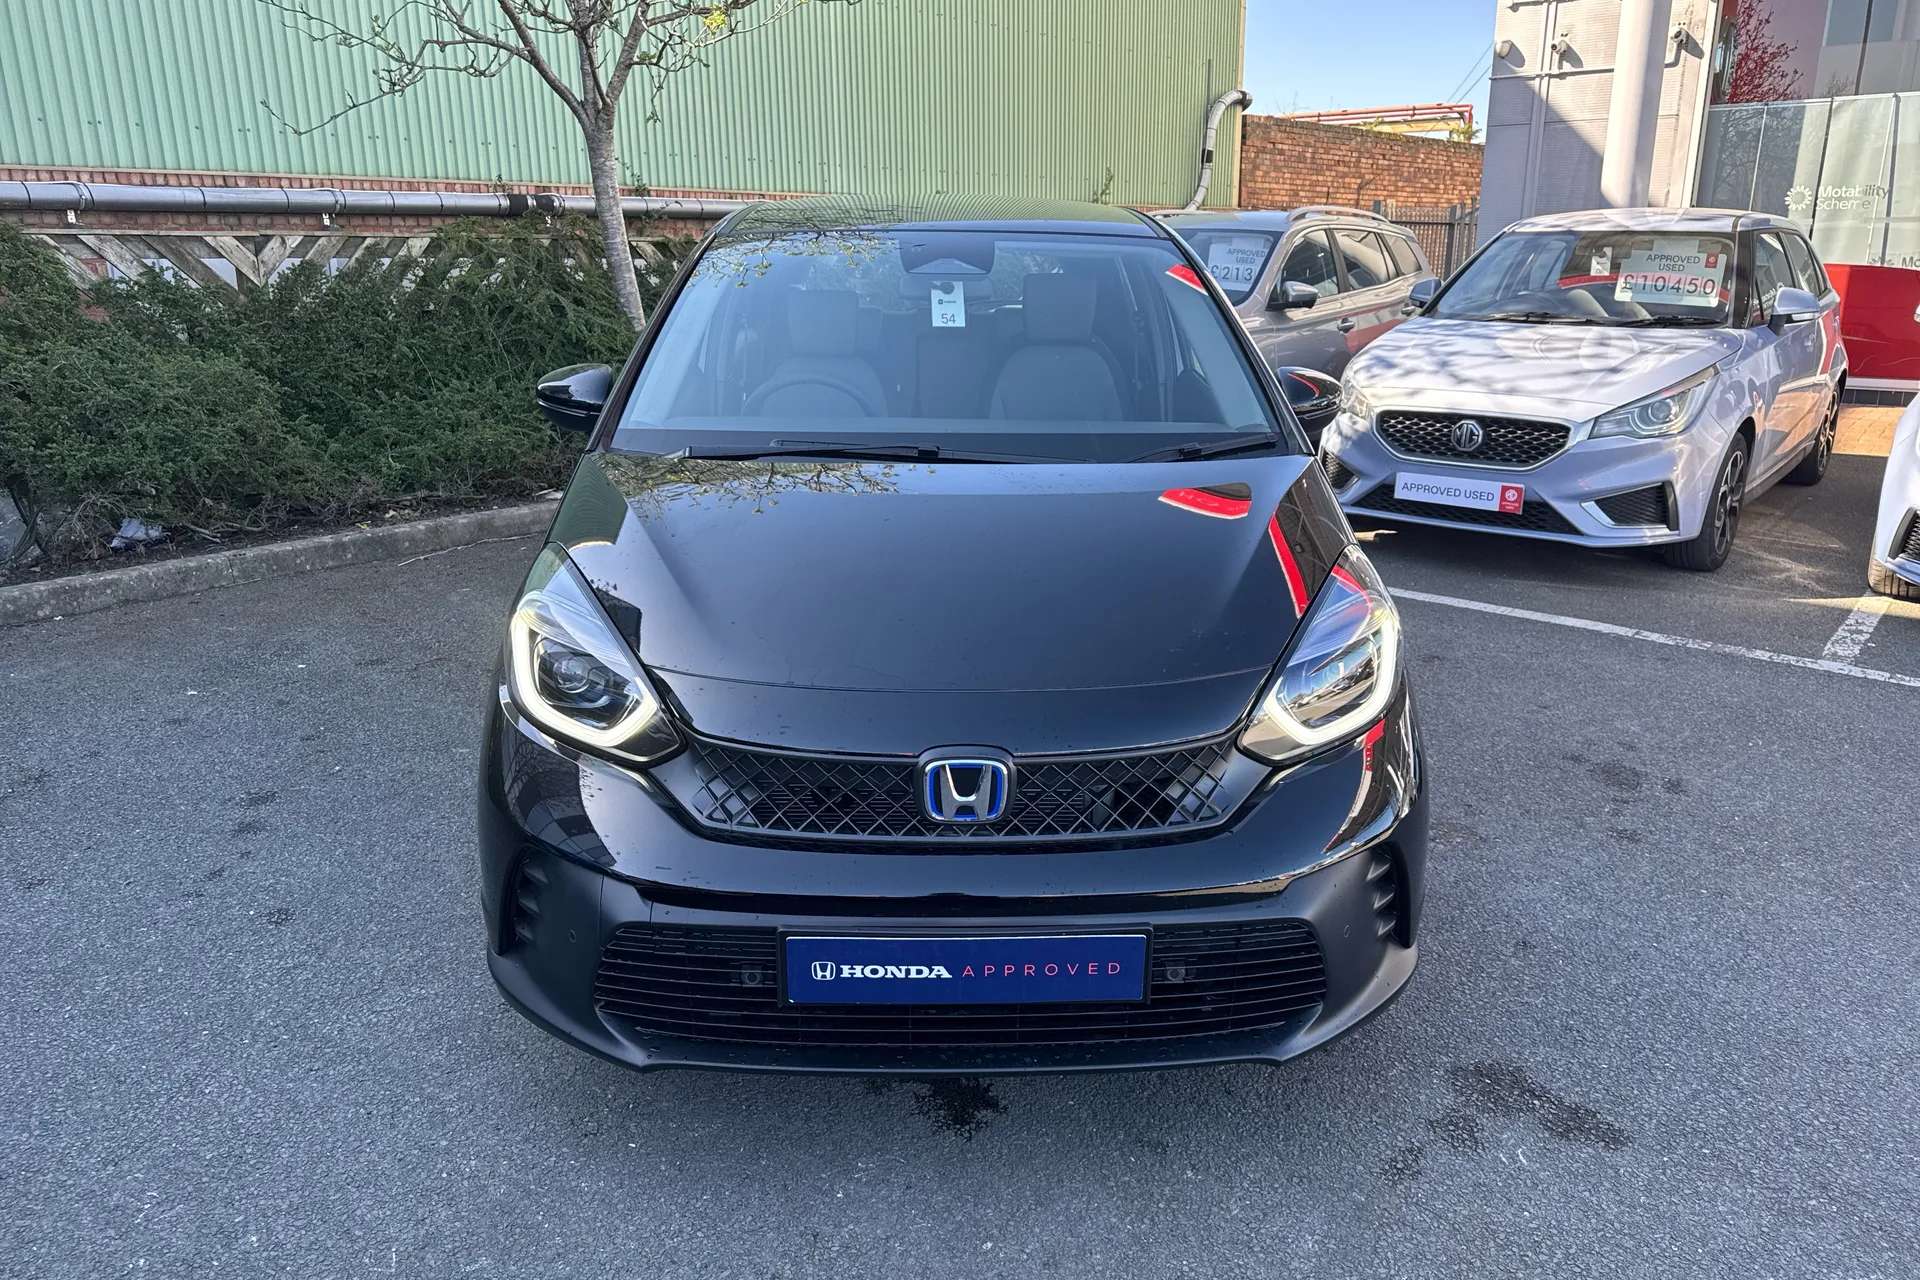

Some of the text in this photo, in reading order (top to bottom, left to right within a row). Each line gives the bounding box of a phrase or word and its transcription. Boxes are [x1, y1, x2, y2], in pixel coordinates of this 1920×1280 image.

[1818, 184, 1889, 200] Motability
[1646, 253, 1701, 265] APPROVED
[1658, 263, 1686, 272] USED
[1621, 274, 1716, 295] £10450
[941, 313, 957, 324] 54
[1453, 423, 1481, 449] MG
[1402, 482, 1495, 501] APPROVED USED
[839, 965, 953, 979] HONDA
[962, 962, 1121, 978] APPROVED
